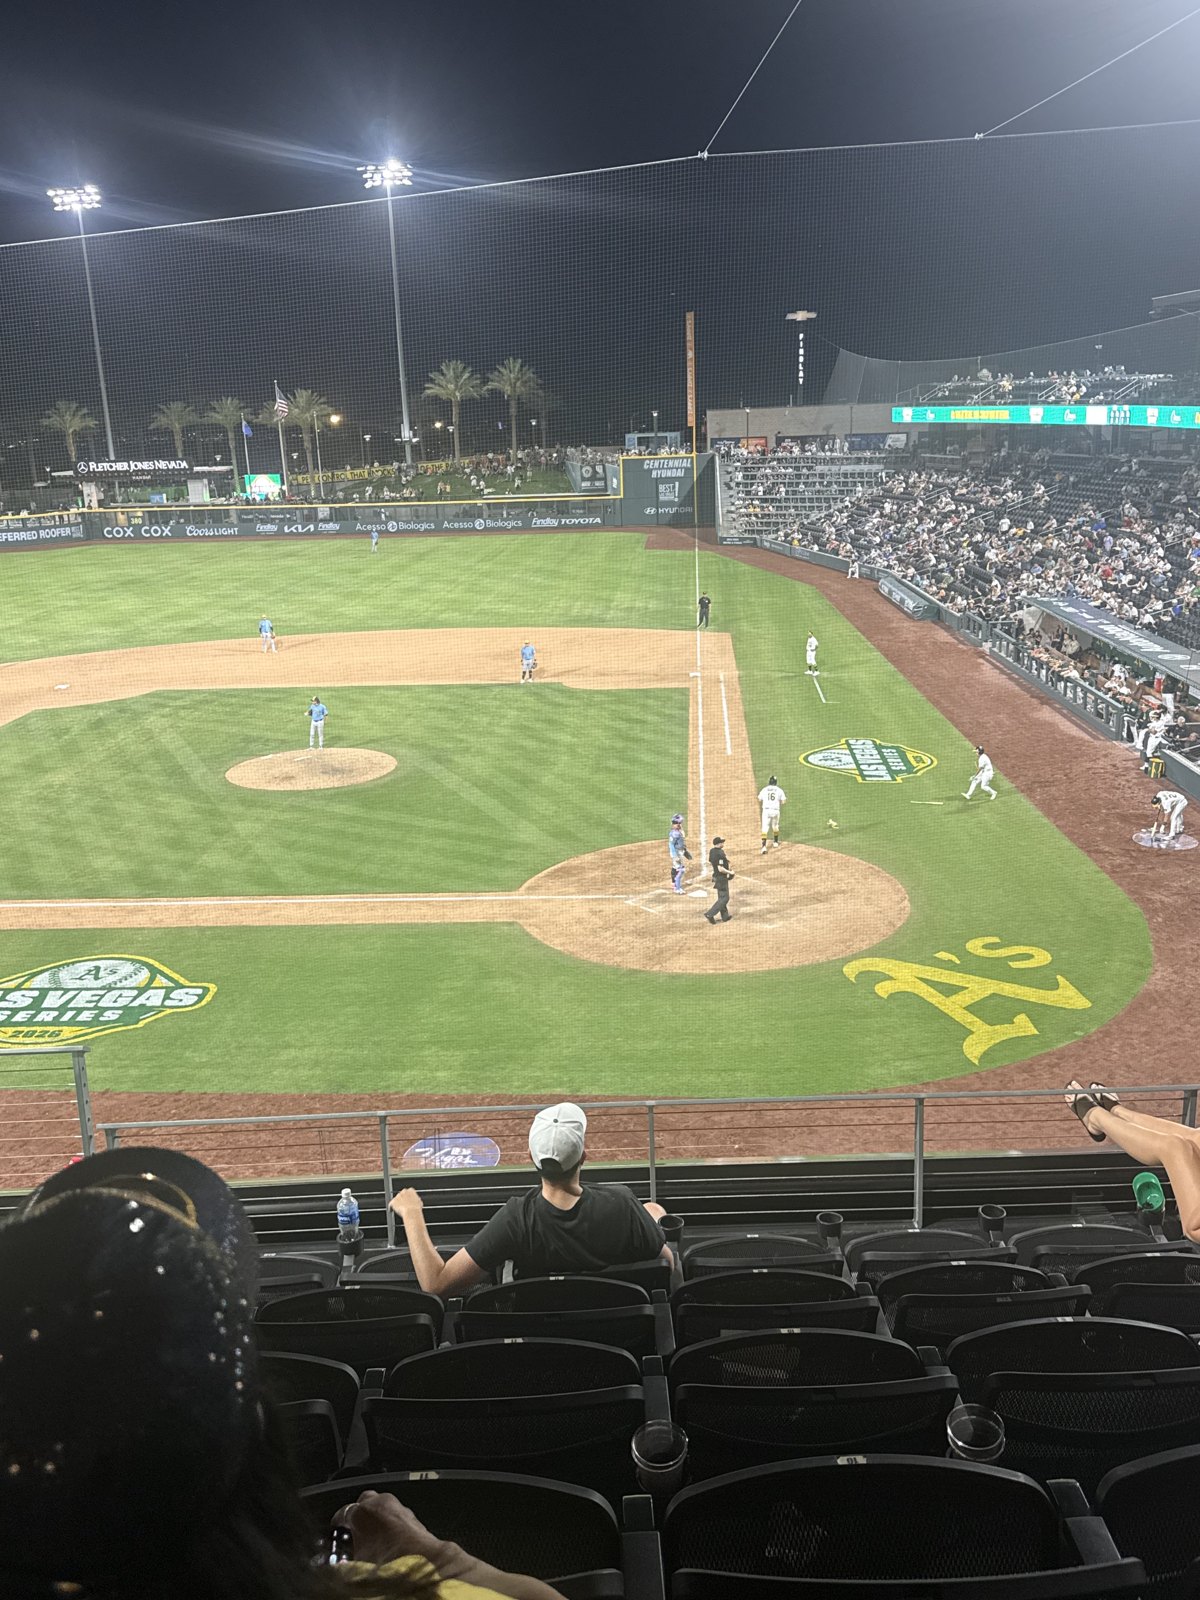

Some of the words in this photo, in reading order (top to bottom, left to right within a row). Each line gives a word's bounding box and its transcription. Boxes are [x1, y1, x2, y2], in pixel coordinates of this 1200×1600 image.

[88, 461, 129, 472] FLETCHER
[129, 460, 154, 472] JONES
[154, 459, 189, 470] NEVADA
[643, 458, 692, 470] CENTENNIAL
[350, 470, 366, 480] THAT
[651, 468, 685, 479] HYUNDAI
[658, 506, 693, 514] HYUNDAI
[355, 522, 386, 531] Acesso
[398, 521, 435, 532] Biologics
[442, 520, 473, 529] Acesso
[485, 518, 522, 529] Biologics
[39, 527, 72, 539] ROOFER
[103, 526, 134, 538] COX
[141, 525, 172, 537] COX
[185, 525, 214, 537] Coors
[214, 527, 239, 535] LIGHT
[70, 965, 120, 981] A's
[0, 989, 40, 1009] S
[41, 987, 204, 1009] VEGAS
[842, 936, 1093, 1066] A's
[8, 1029, 63, 1038] 2026
